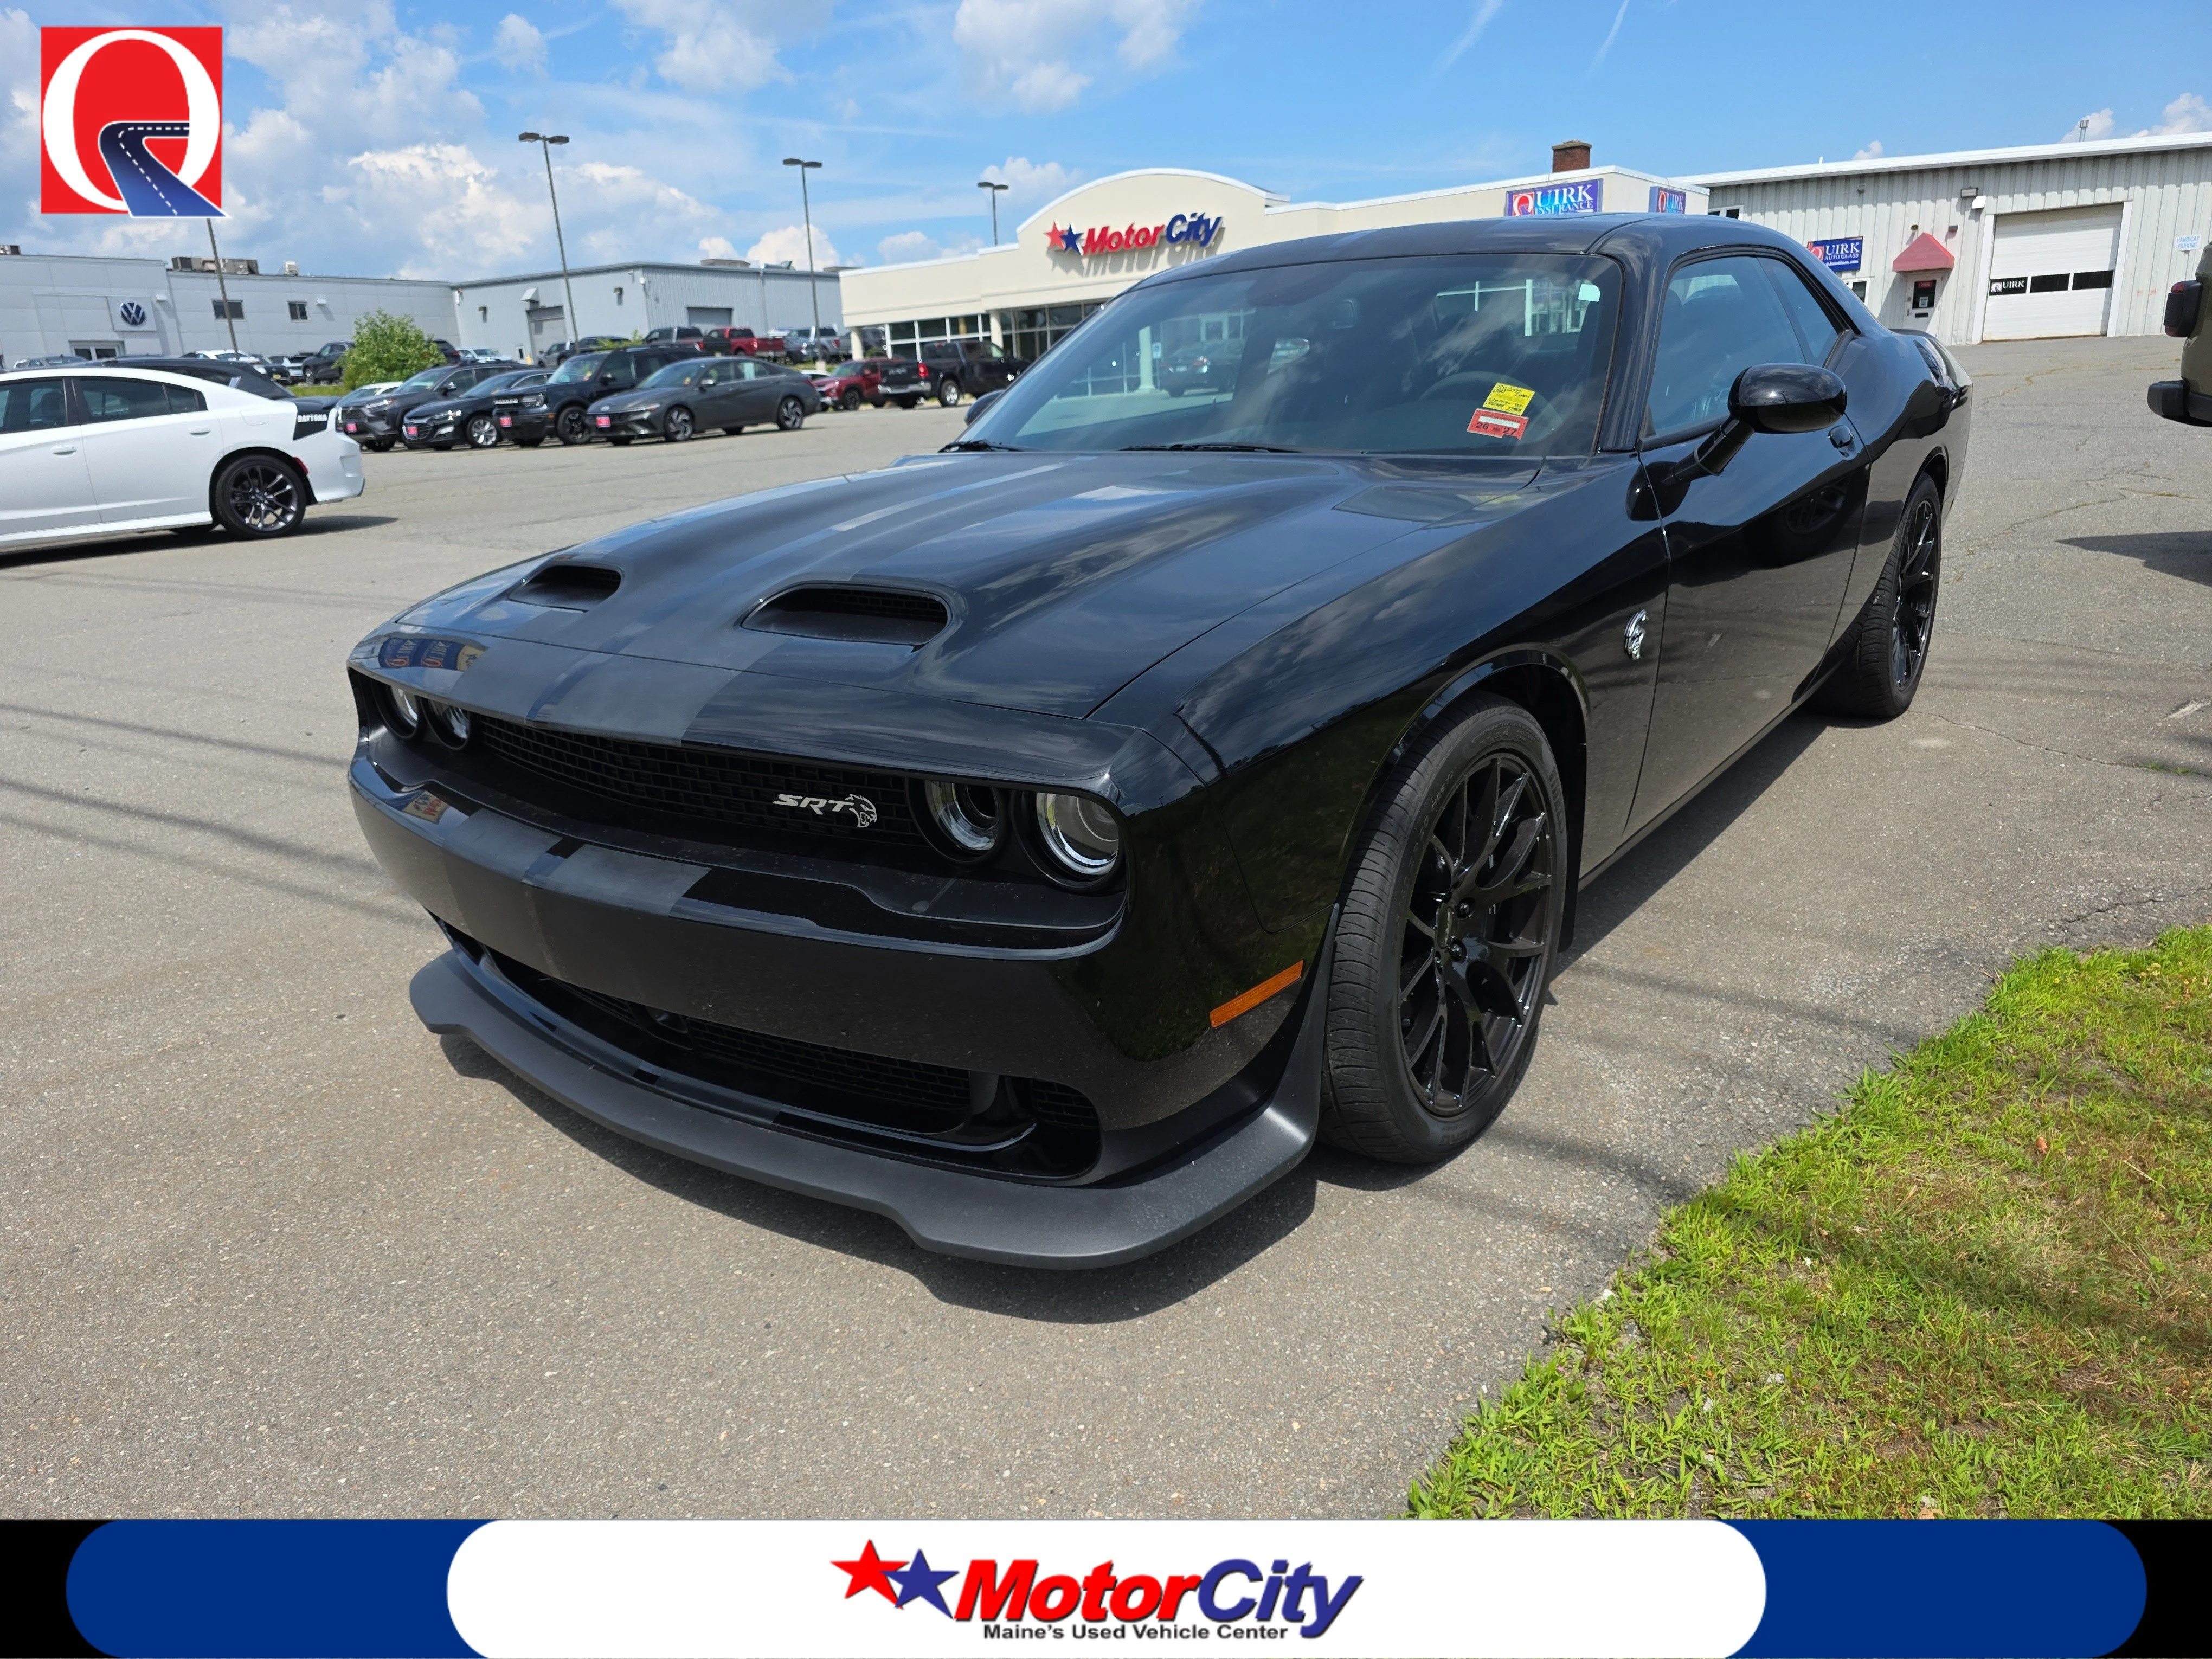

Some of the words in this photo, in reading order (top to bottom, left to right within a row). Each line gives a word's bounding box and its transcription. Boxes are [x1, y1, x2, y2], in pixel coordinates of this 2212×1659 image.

[1084, 212, 1223, 256] MotorCity
[1476, 422, 1489, 430] 26
[1502, 427, 1517, 435] 27
[773, 794, 854, 815] SRT
